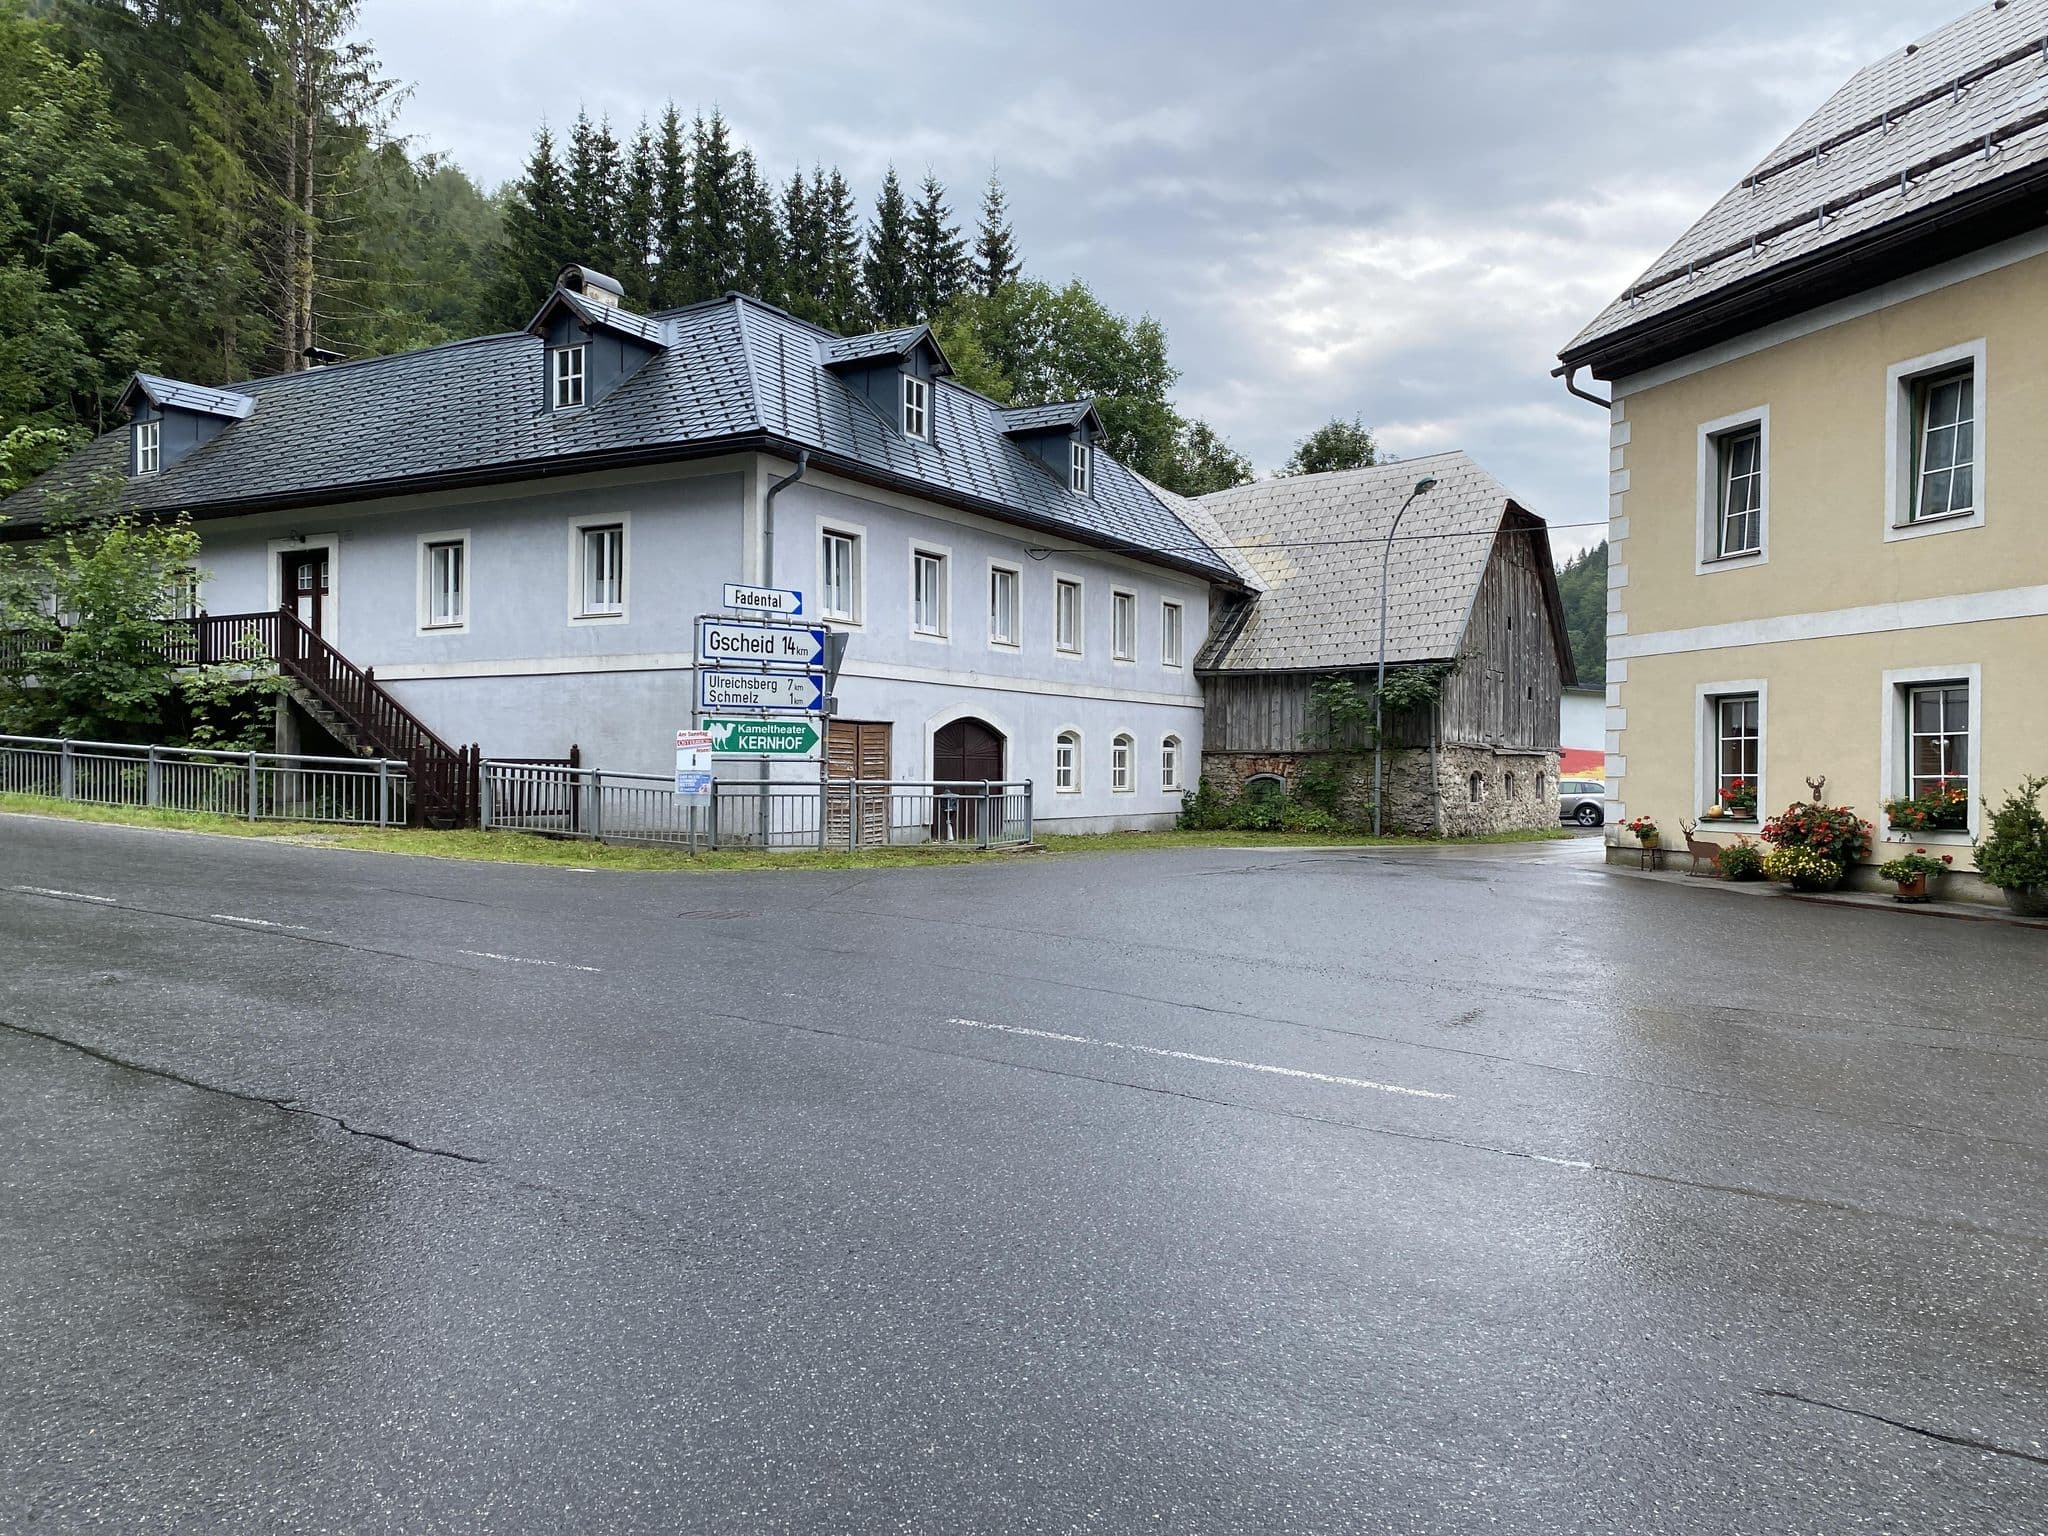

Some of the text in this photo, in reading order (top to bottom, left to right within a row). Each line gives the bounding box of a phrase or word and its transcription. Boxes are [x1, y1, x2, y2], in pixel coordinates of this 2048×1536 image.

[735, 589, 782, 608] Fadental
[710, 631, 809, 656] Gscheid 14 km
[709, 675, 777, 693] Ulreichsberg
[787, 679, 794, 691] 7
[709, 690, 759, 704] Schmelz
[789, 693, 794, 705] 1
[738, 723, 806, 734] Kameltheater
[738, 736, 803, 750] KERNHOF
